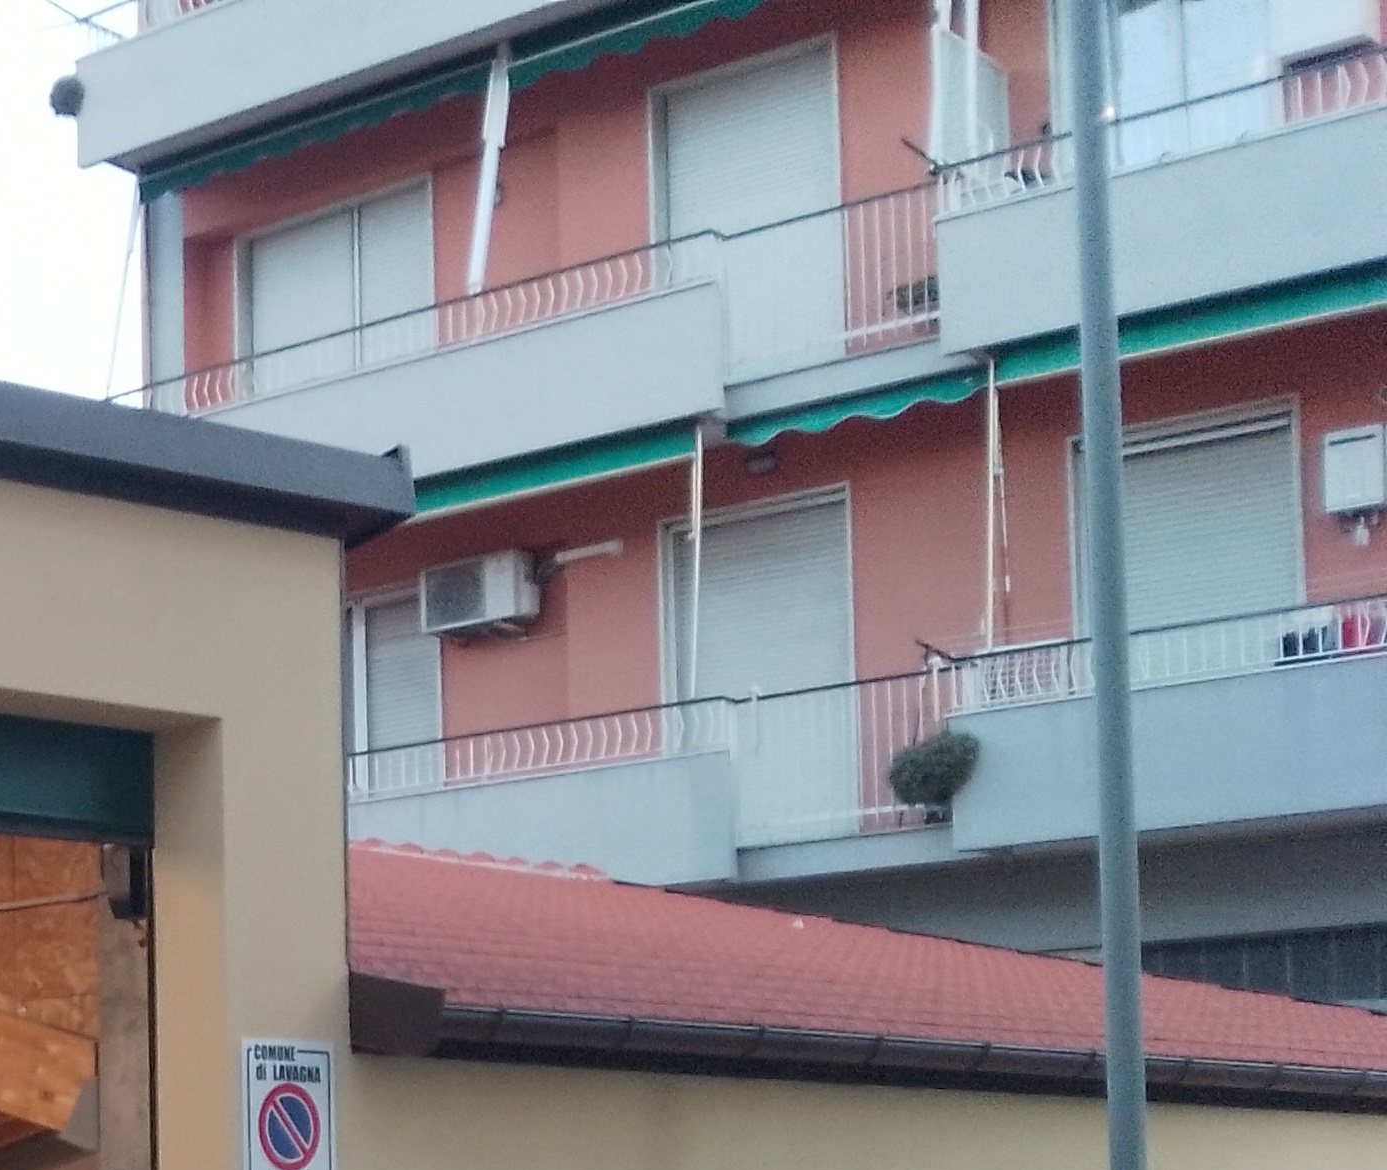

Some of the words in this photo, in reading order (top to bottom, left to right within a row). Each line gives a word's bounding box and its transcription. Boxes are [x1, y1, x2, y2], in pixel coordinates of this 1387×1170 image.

[254, 1044, 295, 1061] COMUNE
[256, 1063, 266, 1080] di
[273, 1064, 321, 1083] LAVAGNA
